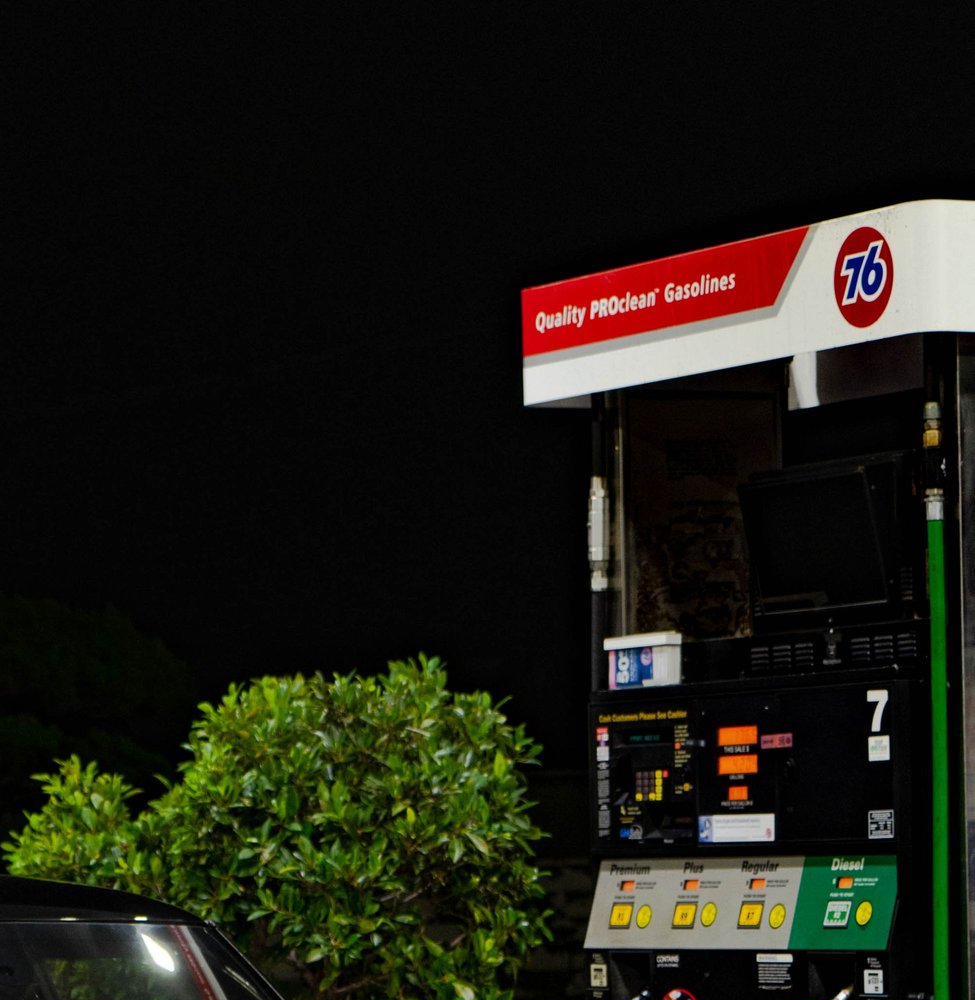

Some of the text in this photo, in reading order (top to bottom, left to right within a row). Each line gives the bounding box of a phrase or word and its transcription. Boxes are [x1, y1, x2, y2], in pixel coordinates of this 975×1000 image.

[841, 239, 889, 306] 76
[535, 304, 586, 333] Quality
[664, 272, 736, 304] Gasolines
[867, 689, 888, 732] 7
[610, 863, 650, 876] Premium
[683, 861, 704, 874] Plus
[741, 860, 779, 875] Regular
[831, 857, 864, 871] Diesel
